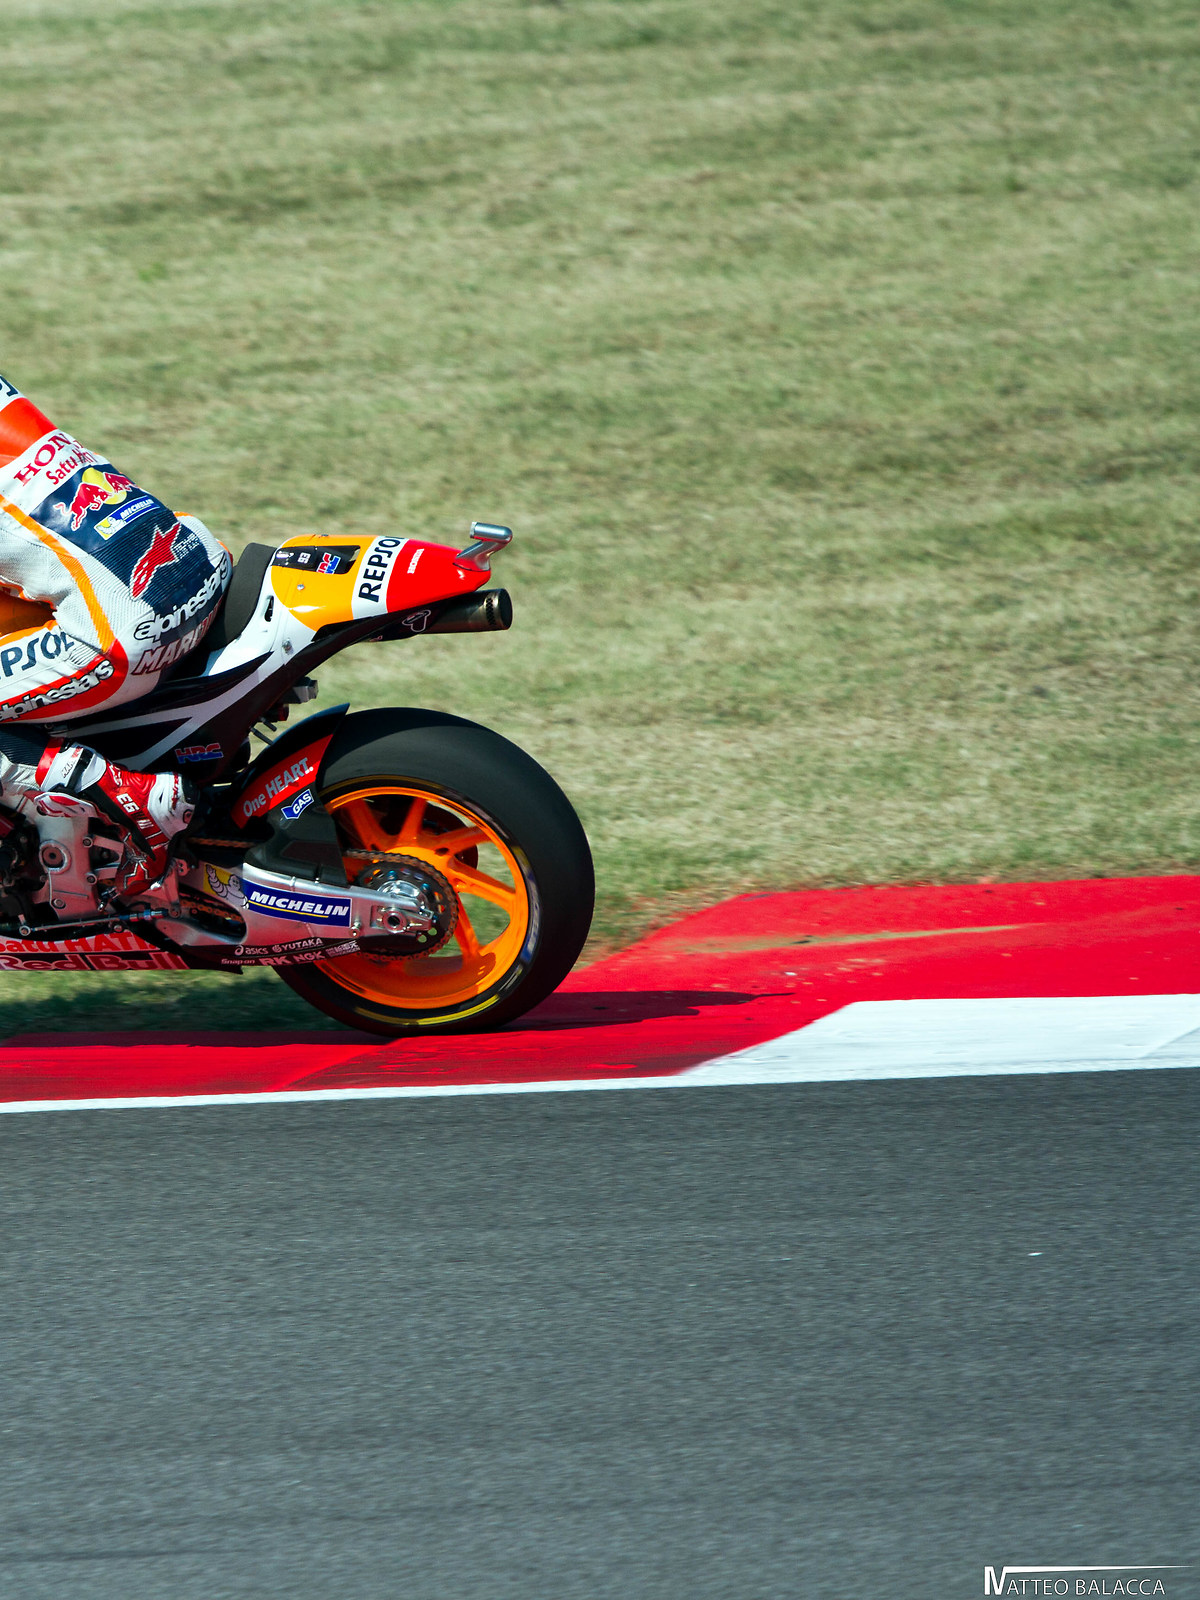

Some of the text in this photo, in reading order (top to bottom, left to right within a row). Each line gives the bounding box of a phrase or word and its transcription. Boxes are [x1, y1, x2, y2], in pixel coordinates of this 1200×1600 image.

[46, 456, 78, 485] Satu
[358, 536, 405, 602] REPSO
[134, 552, 228, 643] alpinestars
[174, 743, 224, 763] HRC
[243, 757, 314, 817] One HEART.
[292, 794, 312, 814] GAS
[250, 891, 350, 916] MICHELIN
[281, 938, 323, 951] YUTAKA
[85, 951, 190, 970] Bull
[259, 956, 292, 966] RK
[293, 951, 325, 962] NGK
